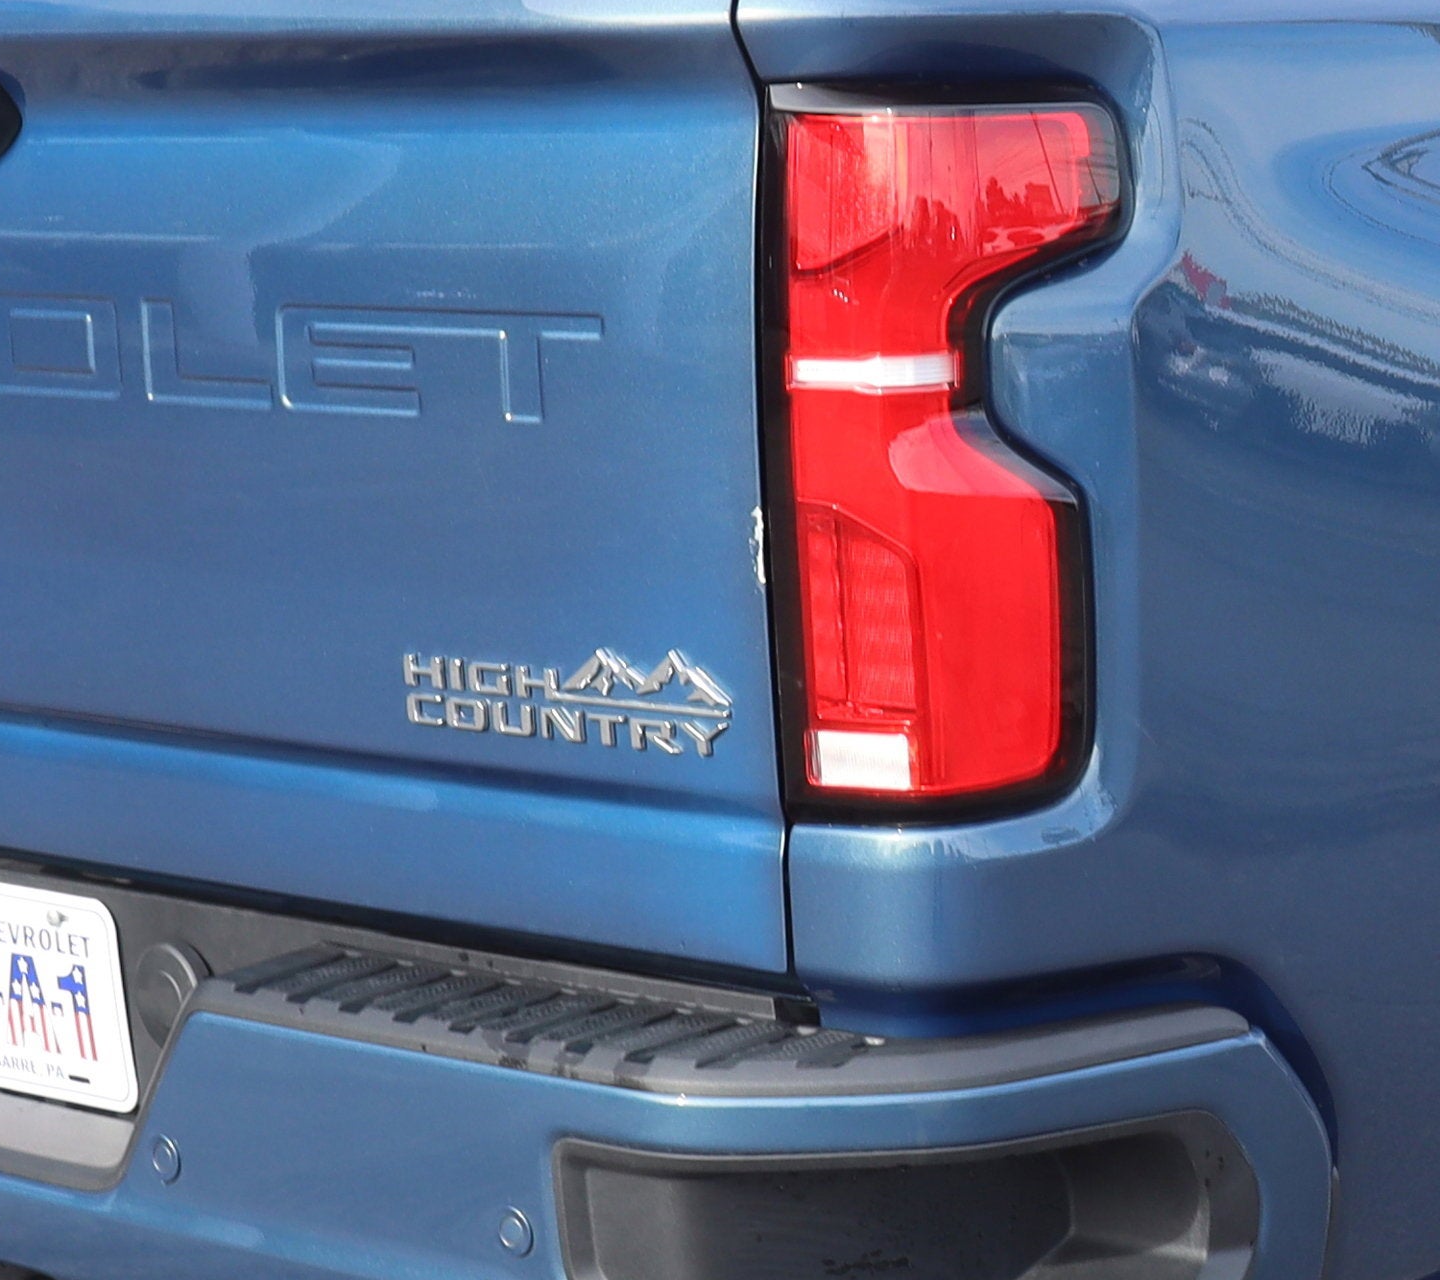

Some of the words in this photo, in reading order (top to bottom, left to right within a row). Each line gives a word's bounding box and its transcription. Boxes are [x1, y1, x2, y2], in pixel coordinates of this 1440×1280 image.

[403, 653, 562, 701] HIGH
[406, 693, 730, 758] COUNTRY
[46, 1063, 66, 1080] PA
